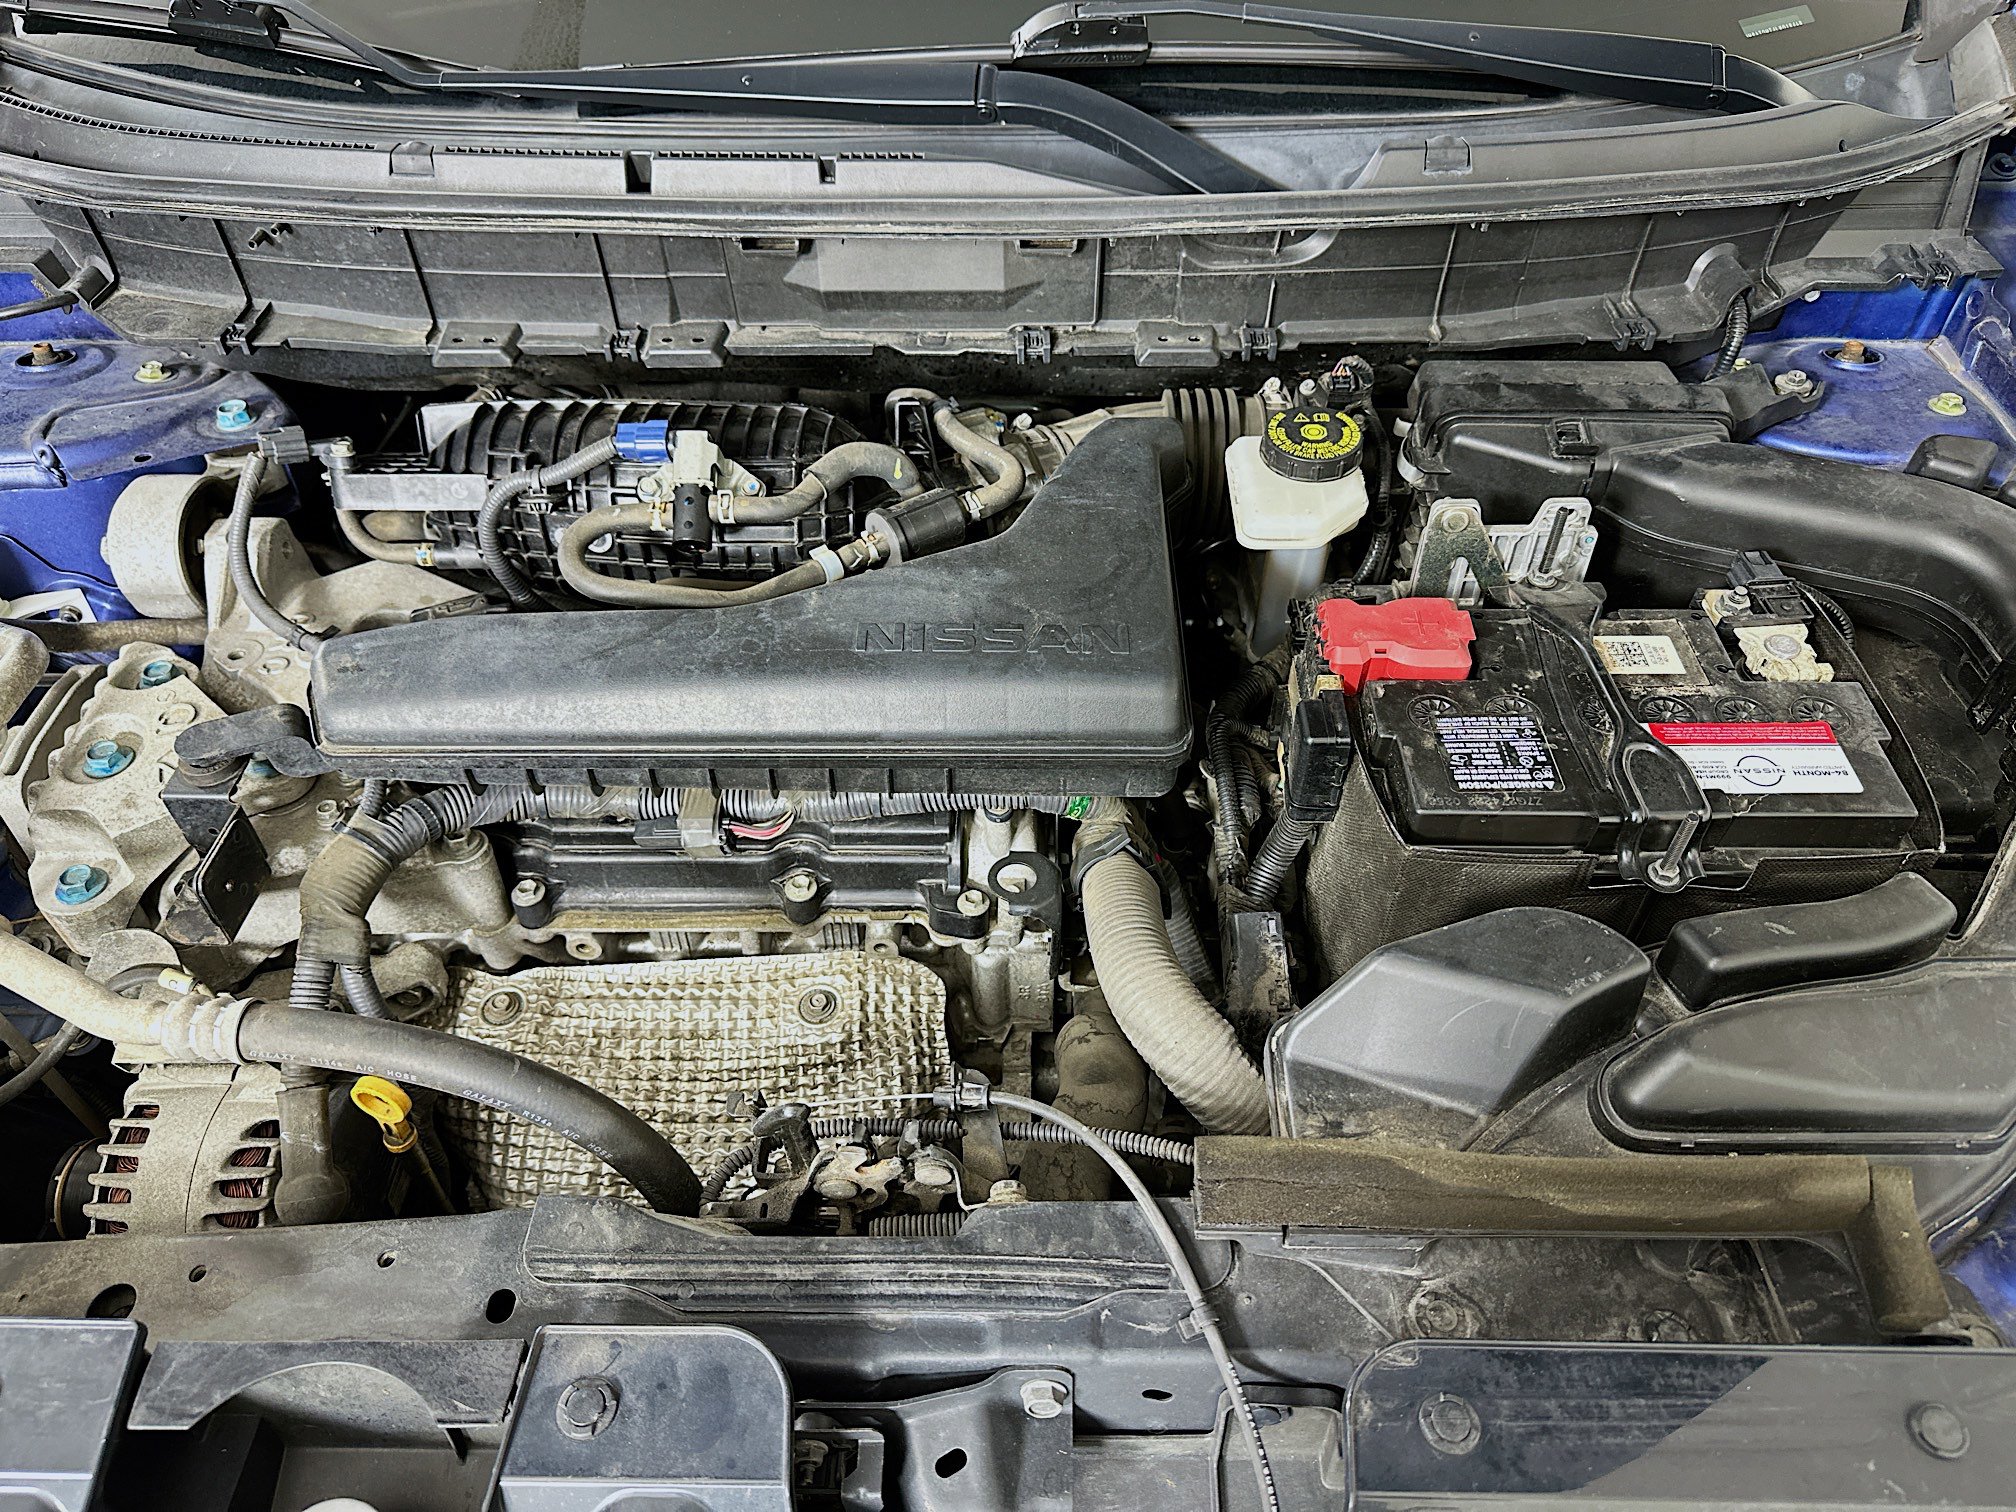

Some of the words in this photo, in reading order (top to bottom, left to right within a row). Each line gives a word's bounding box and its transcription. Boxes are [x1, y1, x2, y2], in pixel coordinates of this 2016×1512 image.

[1294, 450, 1315, 459] BRAKE
[1316, 450, 1336, 460] FLUID
[853, 621, 1132, 655] NISSAN
[1457, 781, 1544, 789] DANGER/POISON
[249, 1050, 297, 1061] GALAXY
[310, 1056, 343, 1067] R134a
[355, 1064, 375, 1073] A/C
[386, 1069, 417, 1082] HOSE
[462, 1088, 513, 1110] GALAXY
[522, 1109, 554, 1128] R134a
[561, 1128, 581, 1142] A/C
[586, 1141, 615, 1160] HOSE
